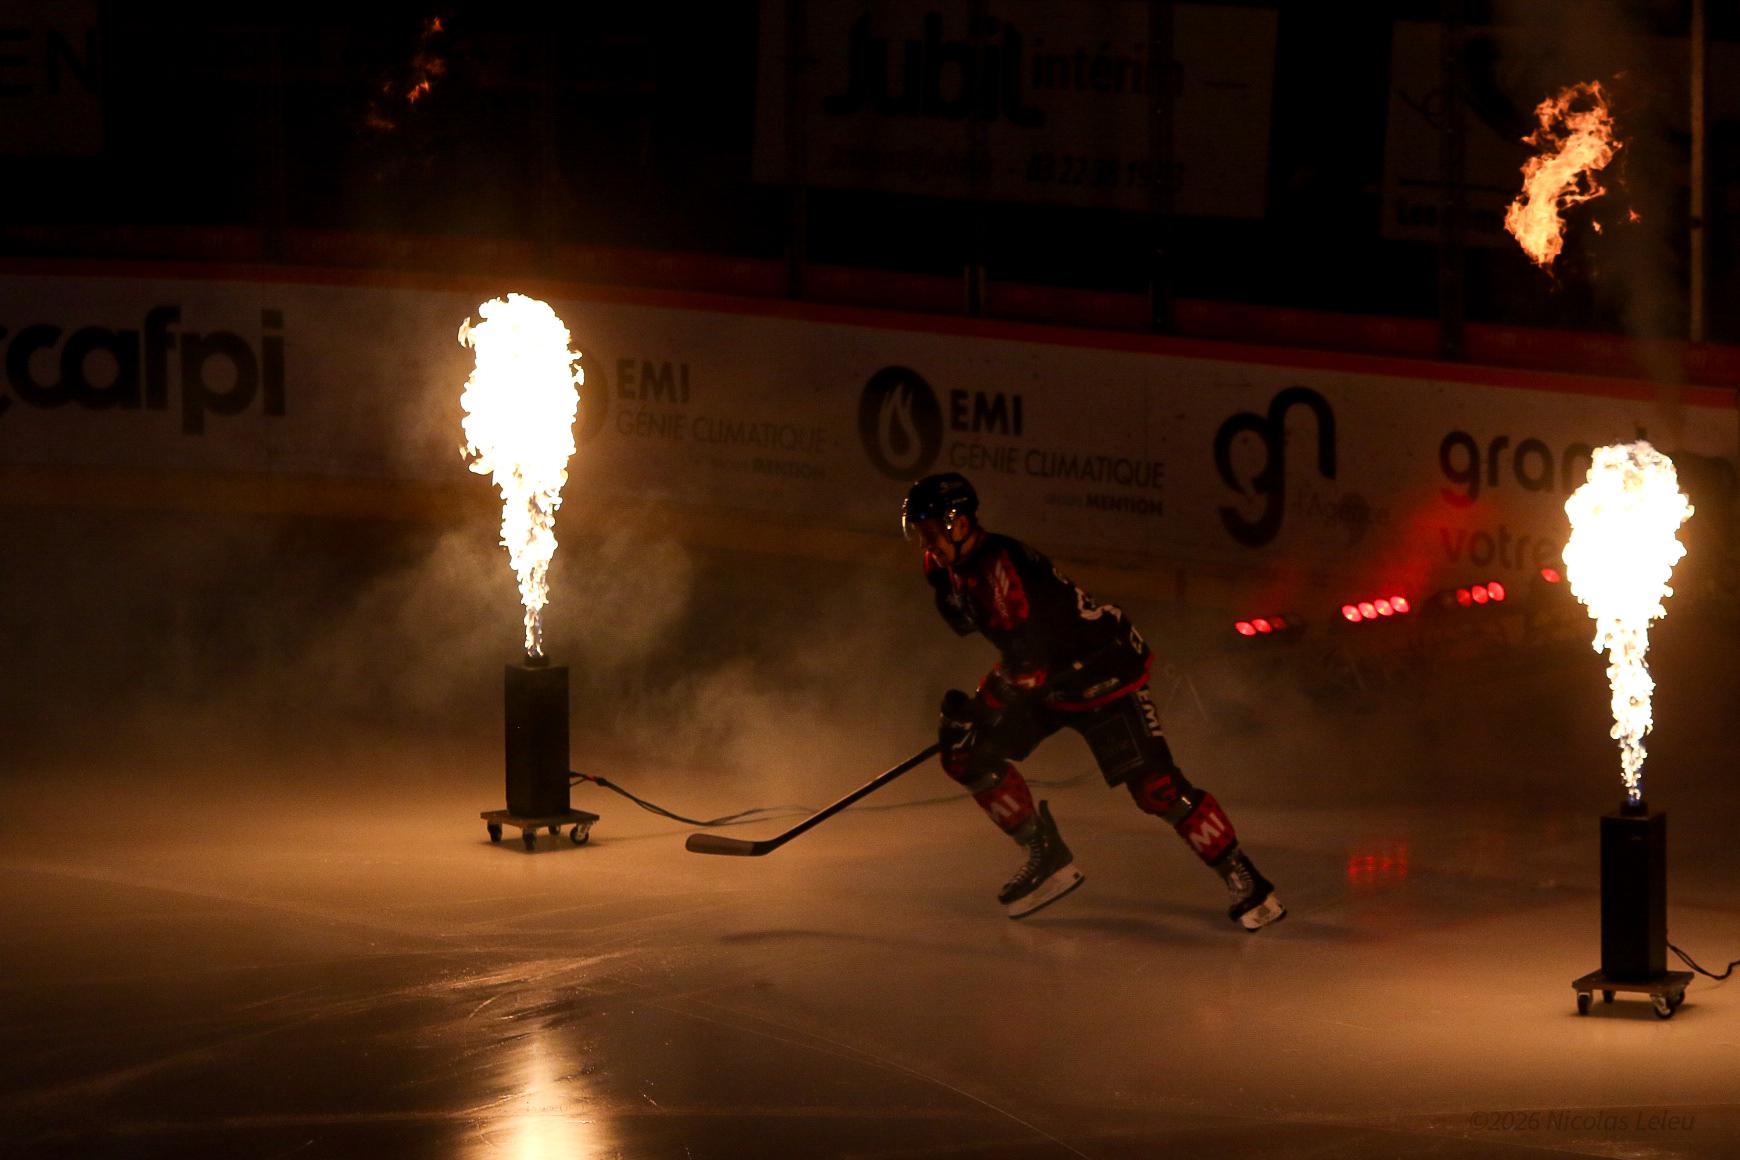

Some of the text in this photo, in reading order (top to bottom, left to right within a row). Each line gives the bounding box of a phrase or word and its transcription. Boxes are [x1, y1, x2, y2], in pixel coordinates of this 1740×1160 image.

[823, 12, 1044, 128] Jubil
[6, 304, 286, 436] cafpi
[616, 358, 690, 404] EMI
[691, 414, 827, 456] CLIMATIQUE
[950, 388, 1023, 437] EMI
[1023, 447, 1166, 490] CLIMATIQUE
[1085, 493, 1163, 517] MENTION
[1440, 524, 1558, 571] votre
